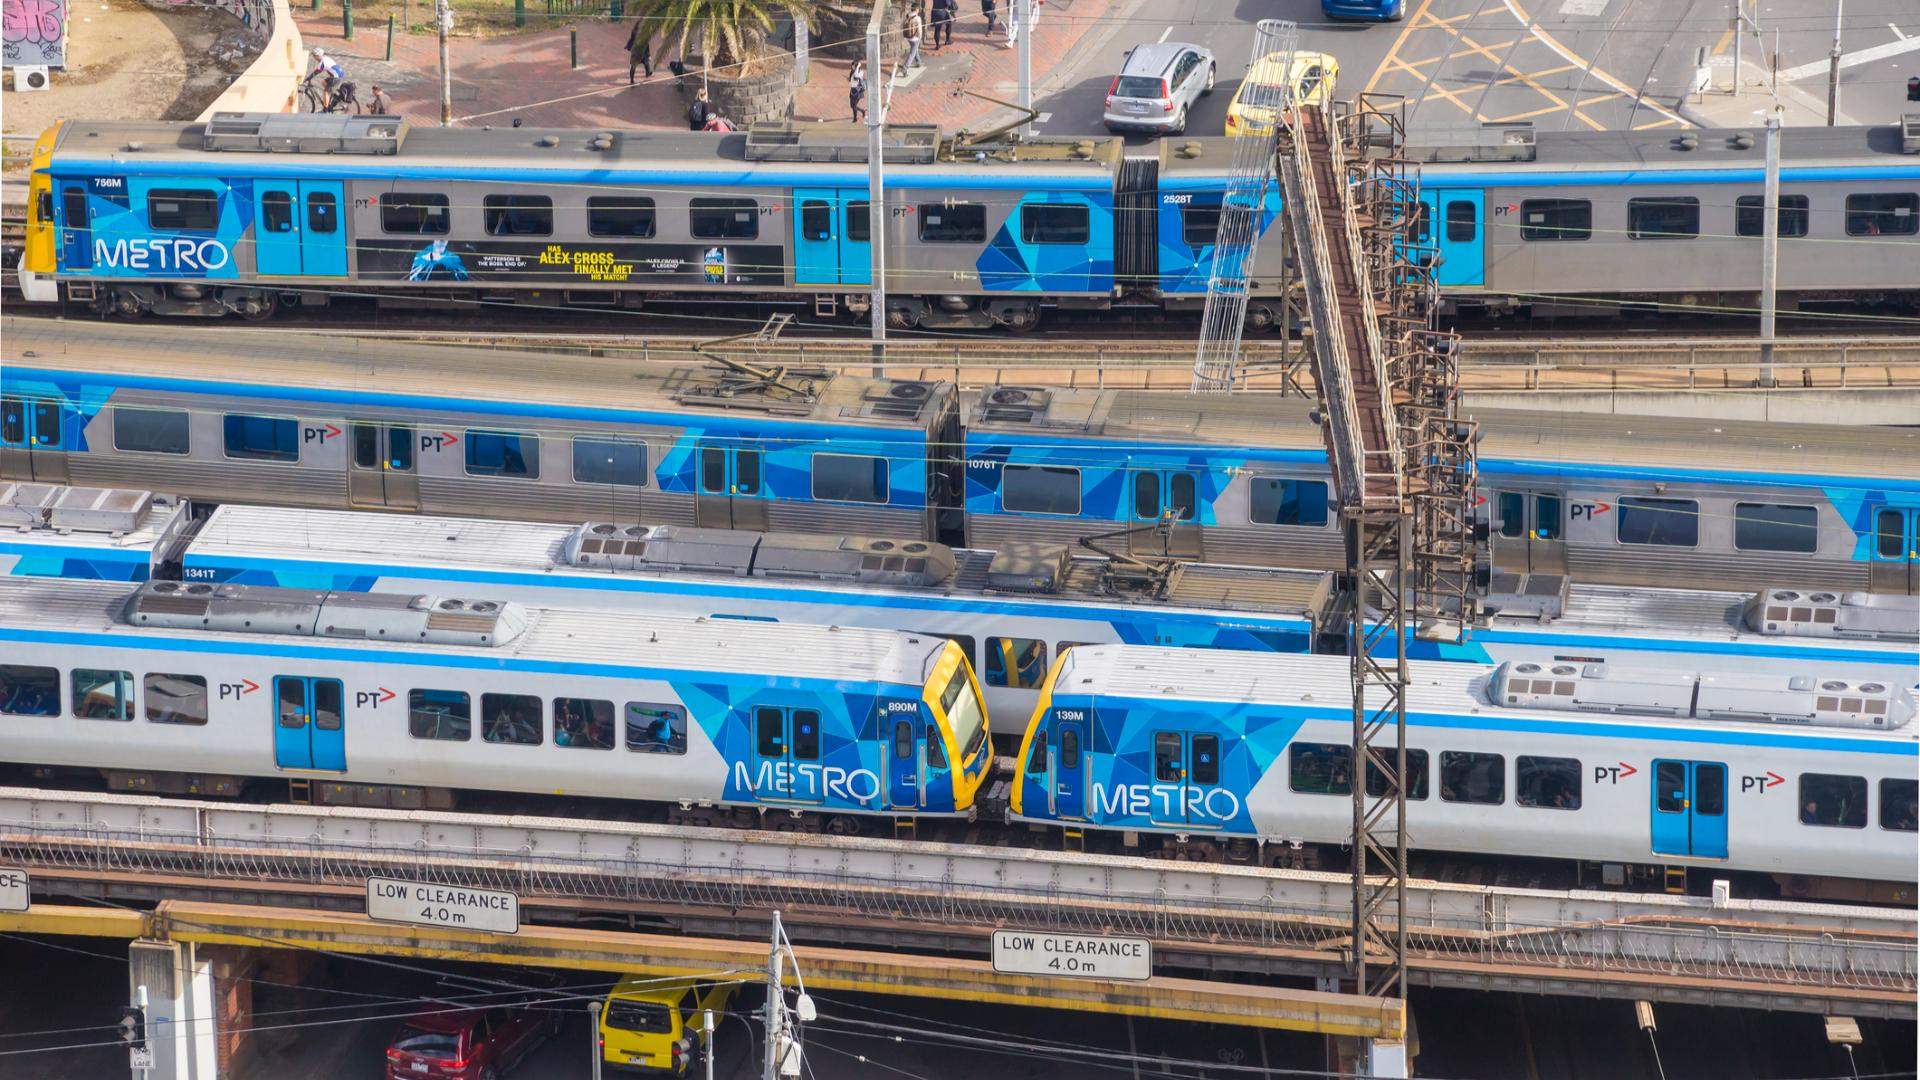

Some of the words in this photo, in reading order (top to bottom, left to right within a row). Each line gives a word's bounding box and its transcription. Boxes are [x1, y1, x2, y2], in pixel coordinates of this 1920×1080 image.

[95, 178, 121, 187] 756M
[1163, 194, 1193, 204] 2528T
[95, 238, 228, 270] METRO
[539, 251, 570, 264] ALEX
[574, 252, 614, 265] CROSS
[574, 264, 610, 274] FINALLY
[613, 265, 633, 274] MET
[185, 568, 215, 579] 1341T
[888, 702, 917, 712] 890M
[1056, 710, 1084, 721] 139M
[735, 761, 880, 801] METRO
[1093, 782, 1239, 821] METRO
[377, 884, 408, 899] LOW
[416, 888, 509, 910] CLEARANCE
[1002, 936, 1034, 951] LOW
[1044, 939, 1142, 957] CLEARANCE
